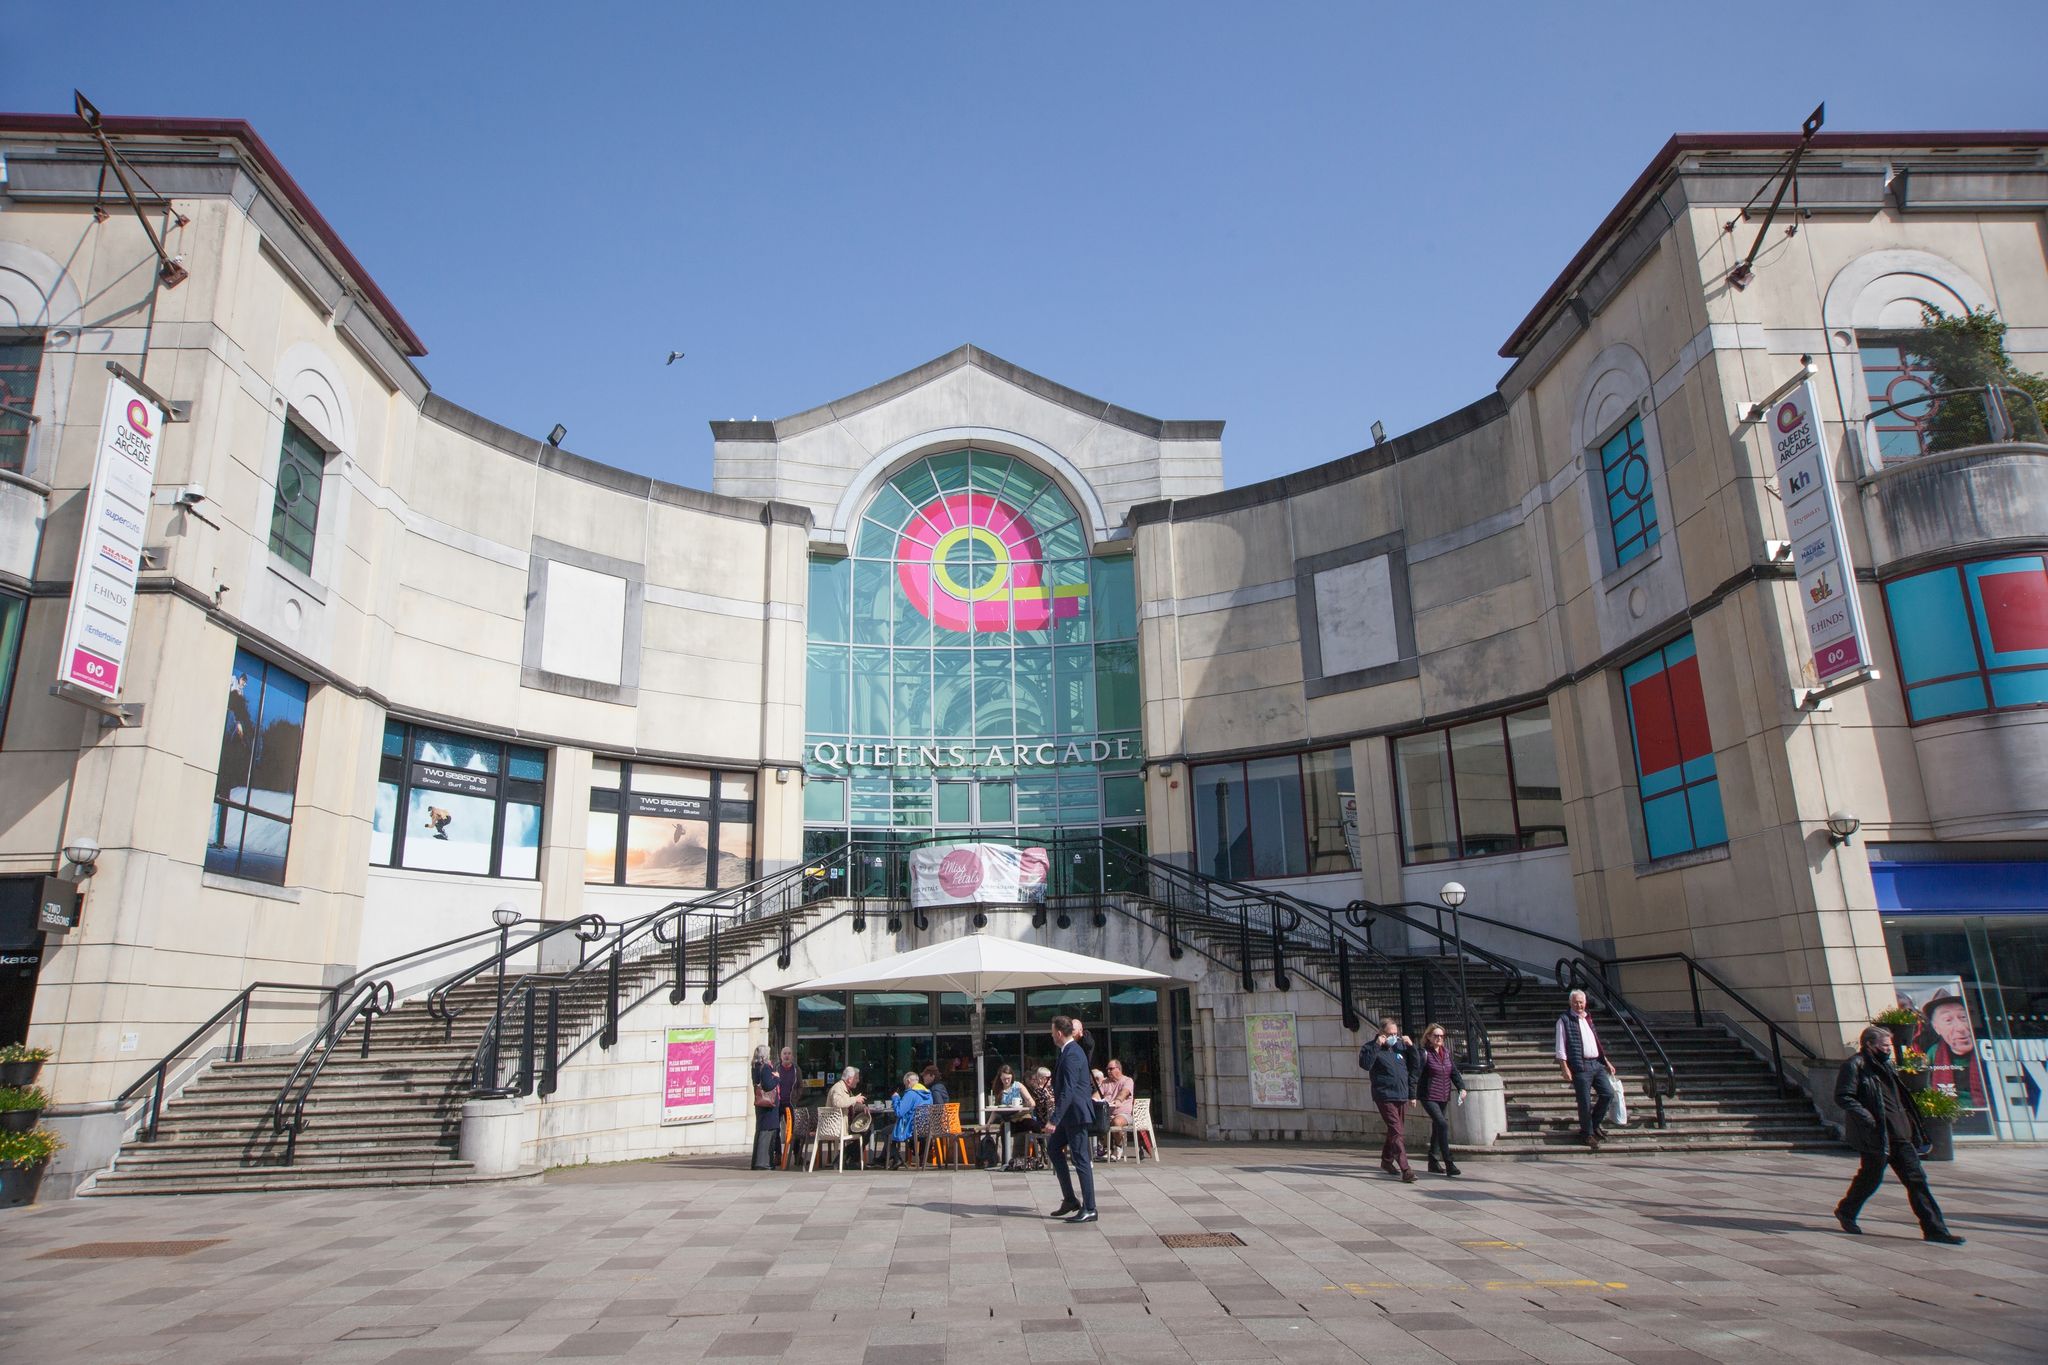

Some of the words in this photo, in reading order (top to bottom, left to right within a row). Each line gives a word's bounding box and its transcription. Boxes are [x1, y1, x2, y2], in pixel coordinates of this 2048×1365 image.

[118, 425, 151, 455] QUEENS
[1778, 423, 1810, 452] QUEENS
[1780, 434, 1813, 463] ARCADE
[115, 437, 149, 466] ARCADE
[1789, 471, 1810, 494] kh
[94, 583, 127, 607] F.HINDS
[1811, 610, 1845, 634] F.HINDS
[814, 742, 966, 769] QUEENS
[984, 738, 1134, 766] ARCADE
[423, 767, 444, 778] TWO
[640, 797, 660, 805] TWO
[942, 860, 967, 875] Miss
[952, 870, 980, 885] Petals
[46, 913, 70, 927] SEASONS
[47, 902, 61, 915] TWO
